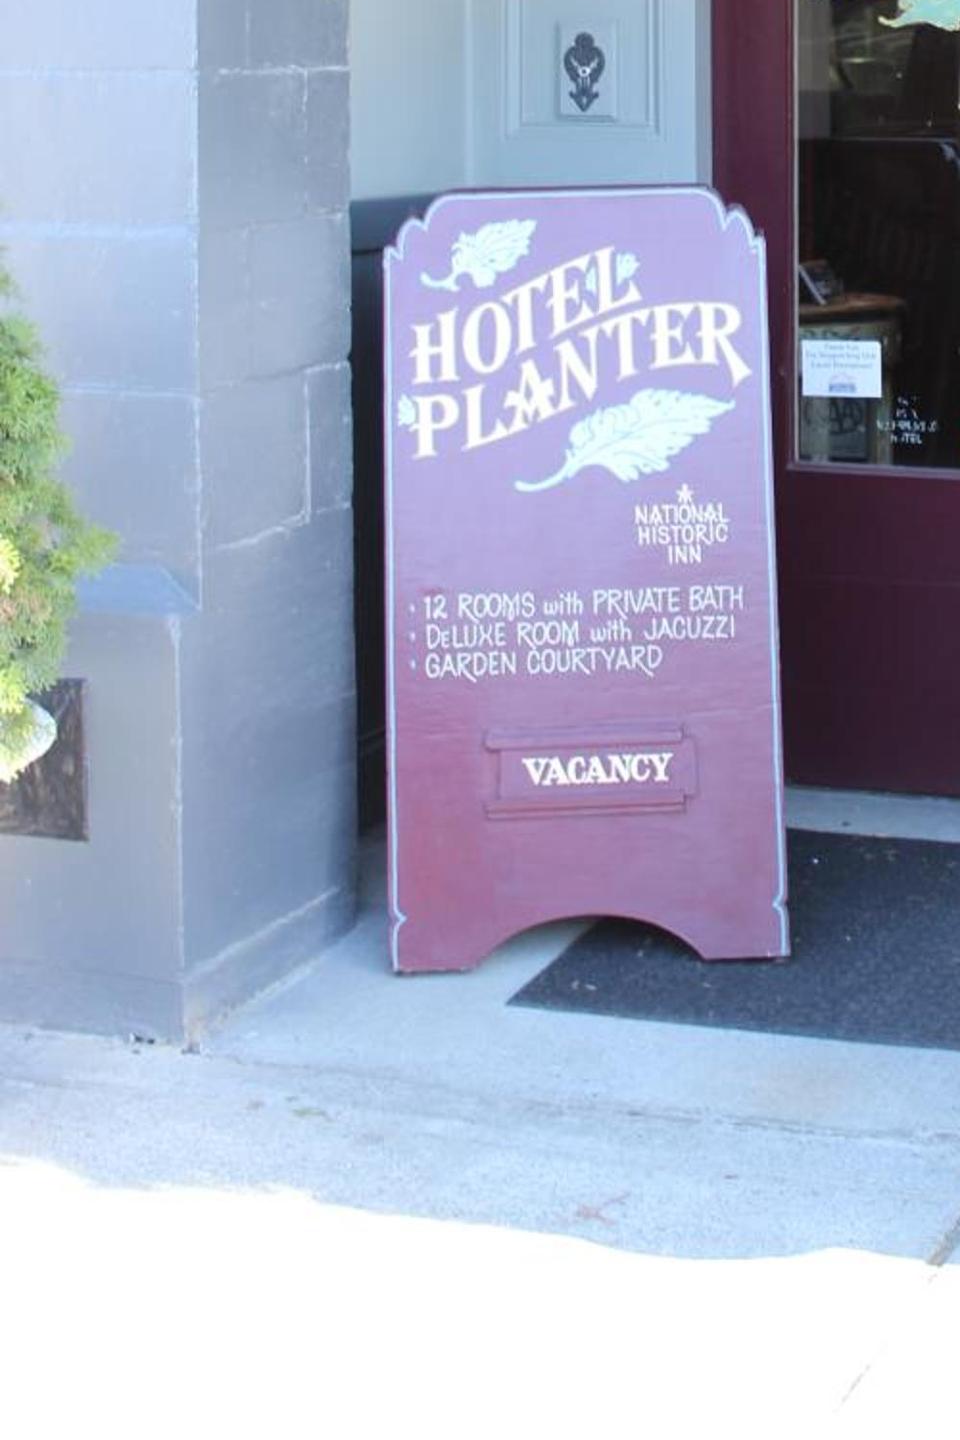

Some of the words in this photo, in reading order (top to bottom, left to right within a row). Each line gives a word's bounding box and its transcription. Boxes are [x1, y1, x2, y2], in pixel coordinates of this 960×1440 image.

[409, 246, 643, 384] HOTEL
[410, 302, 753, 459] PLANTER
[634, 503, 730, 526] NATIONAL
[637, 523, 729, 545] HISTORIC
[667, 545, 702, 565] INN
[424, 595, 448, 619] 12
[458, 592, 535, 623] ROOMS
[543, 591, 584, 616] with
[592, 588, 680, 620] PRIVATE
[689, 585, 745, 611] BATH
[516, 621, 580, 650] ROOM
[590, 618, 633, 643] with
[643, 614, 736, 640] JACUZZI
[425, 652, 517, 682] GARDEN
[527, 646, 664, 677] COURTYARD
[522, 753, 674, 786] VACANCY
